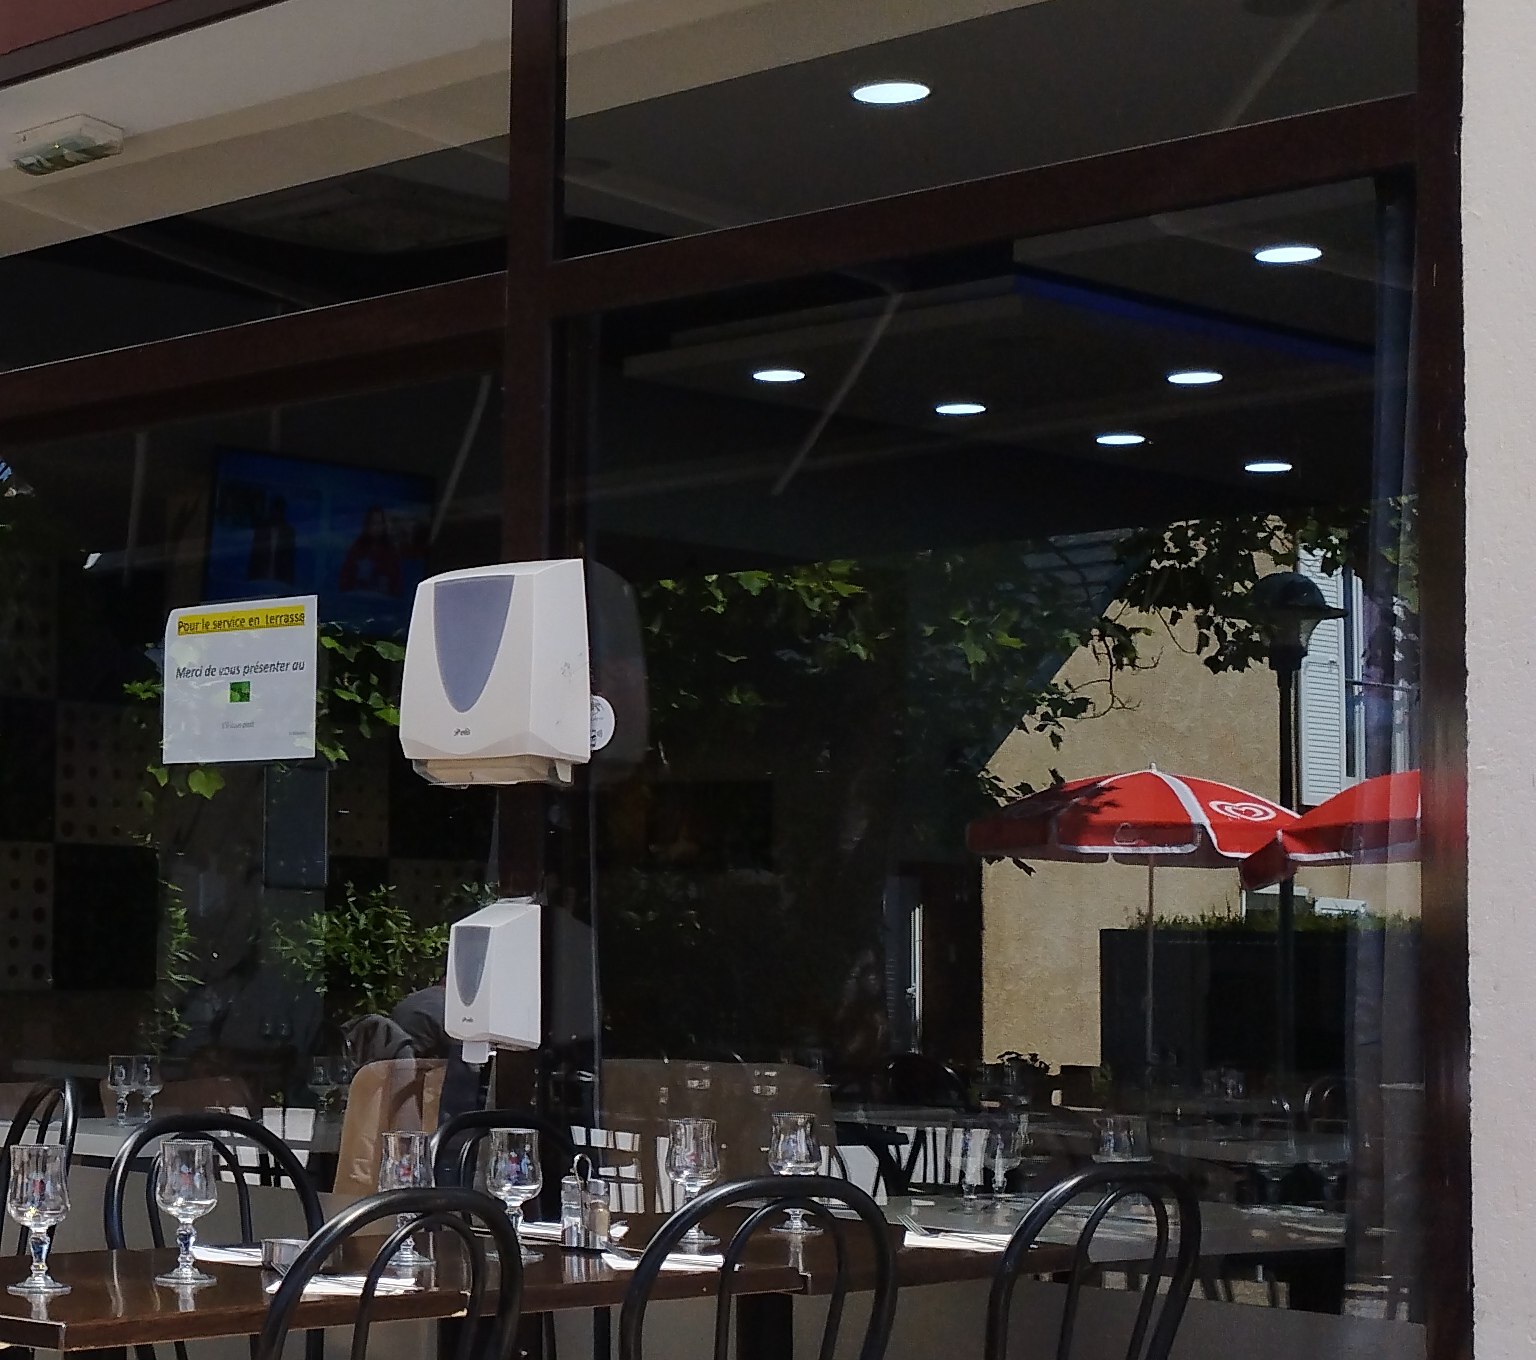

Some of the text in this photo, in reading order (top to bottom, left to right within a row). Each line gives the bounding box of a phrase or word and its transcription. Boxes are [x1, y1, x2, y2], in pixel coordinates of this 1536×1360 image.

[178, 620, 202, 633] Pour
[213, 616, 246, 630] service
[248, 616, 260, 627] en
[265, 612, 305, 625] terrasse
[175, 660, 305, 679] Merci de vous présenter au
